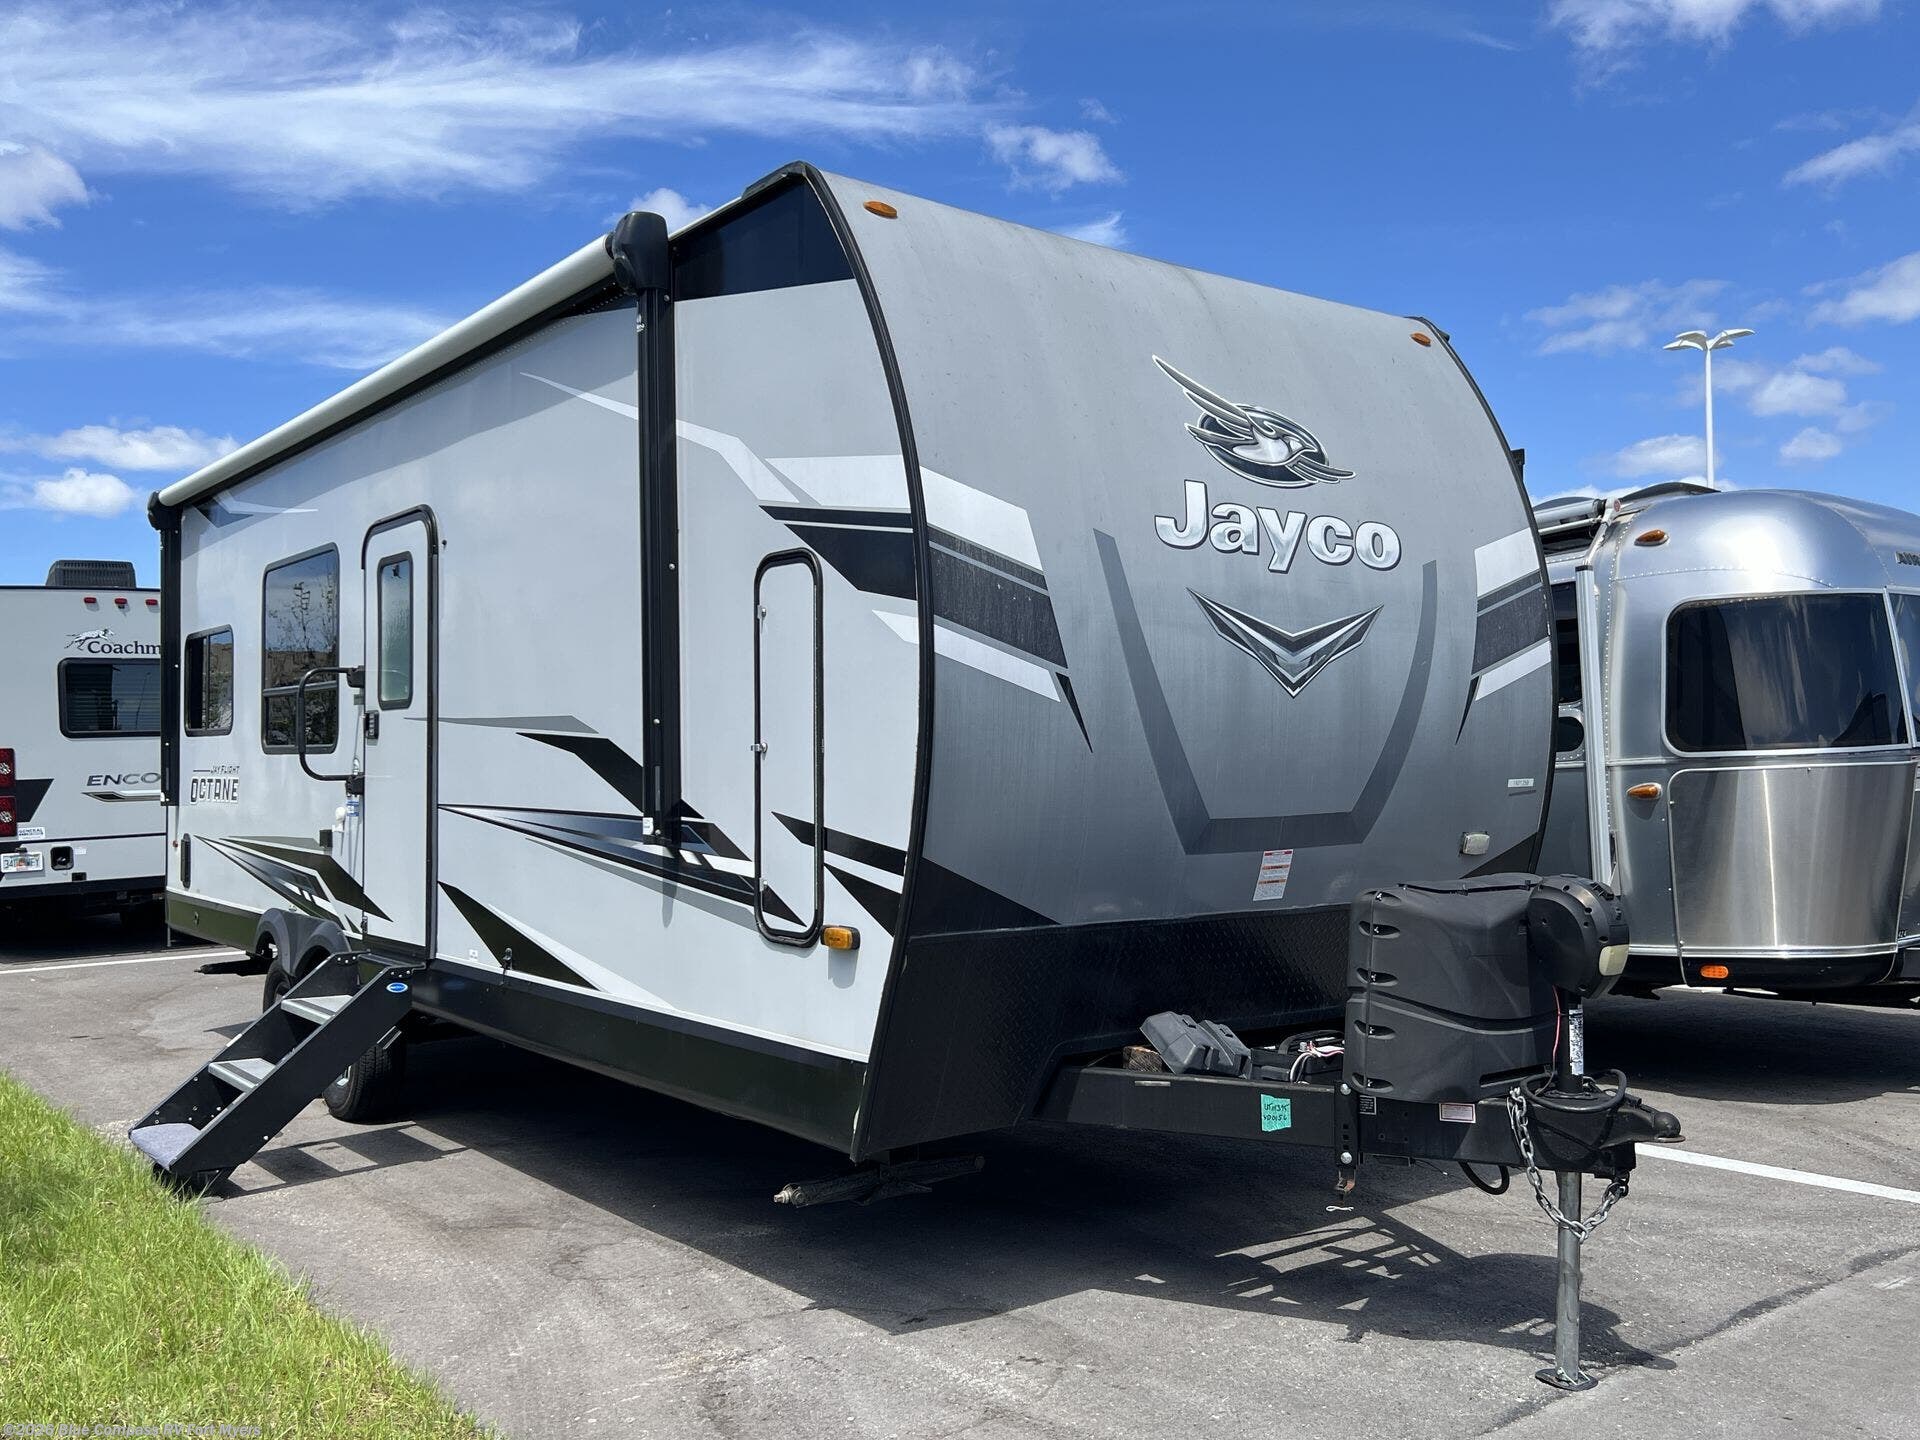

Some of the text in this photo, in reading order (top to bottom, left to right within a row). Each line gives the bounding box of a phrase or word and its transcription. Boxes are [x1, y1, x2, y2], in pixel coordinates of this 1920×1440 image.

[1154, 480, 1402, 574] Jayco
[86, 772, 161, 787] ENCO
[189, 777, 240, 804] OCTANE
